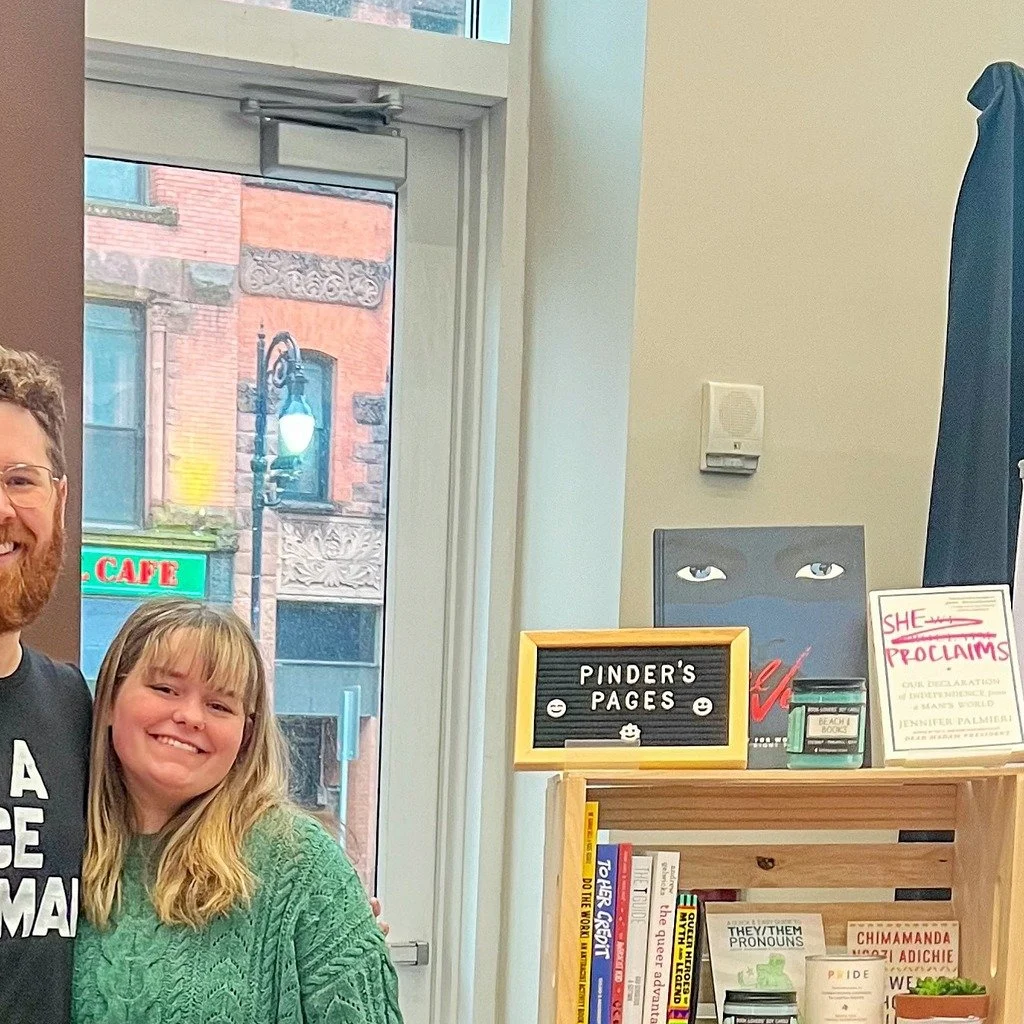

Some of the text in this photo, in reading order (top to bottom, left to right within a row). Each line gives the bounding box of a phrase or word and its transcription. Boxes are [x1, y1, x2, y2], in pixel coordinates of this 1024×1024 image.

[95, 557, 179, 587] CAFE
[883, 608, 926, 634] SHE
[885, 641, 1009, 667] PROCLAIMS
[579, 660, 697, 686] PINDER'S
[590, 689, 676, 711] PAGES
[899, 715, 1012, 729] JENNIFER PALMIERI
[10, 739, 49, 800] A
[658, 904, 670, 926] the
[727, 926, 802, 936] THEY/THEM
[729, 936, 803, 947] PRONOUNS
[857, 931, 951, 944] CHIMAMANDA
[653, 930, 666, 968] queer
[898, 949, 954, 963] ADICHIE
[828, 969, 870, 980] PRIDE
[890, 976, 912, 990] WE
